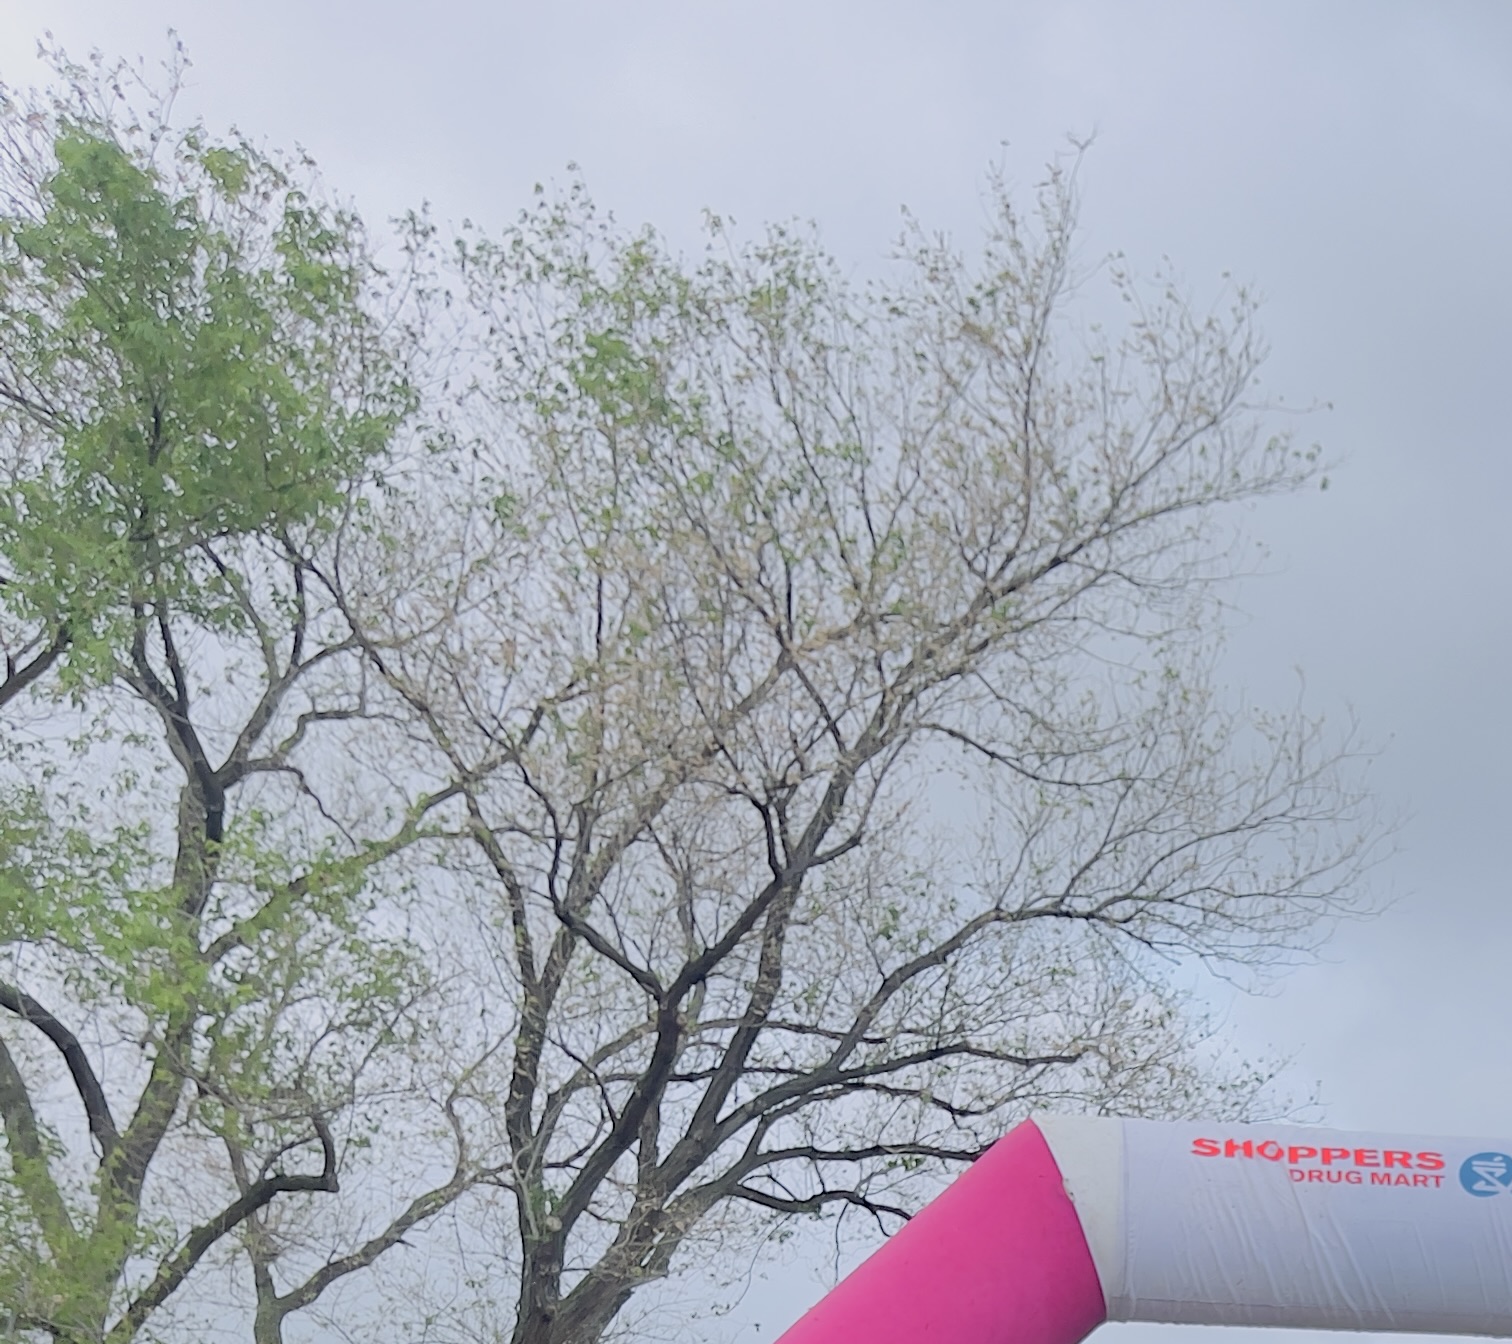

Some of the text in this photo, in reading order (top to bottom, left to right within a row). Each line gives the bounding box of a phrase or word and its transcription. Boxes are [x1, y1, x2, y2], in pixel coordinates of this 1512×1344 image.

[1191, 1138, 1446, 1171] SHOPPERS
[1289, 1168, 1446, 1188] DRUG MART
